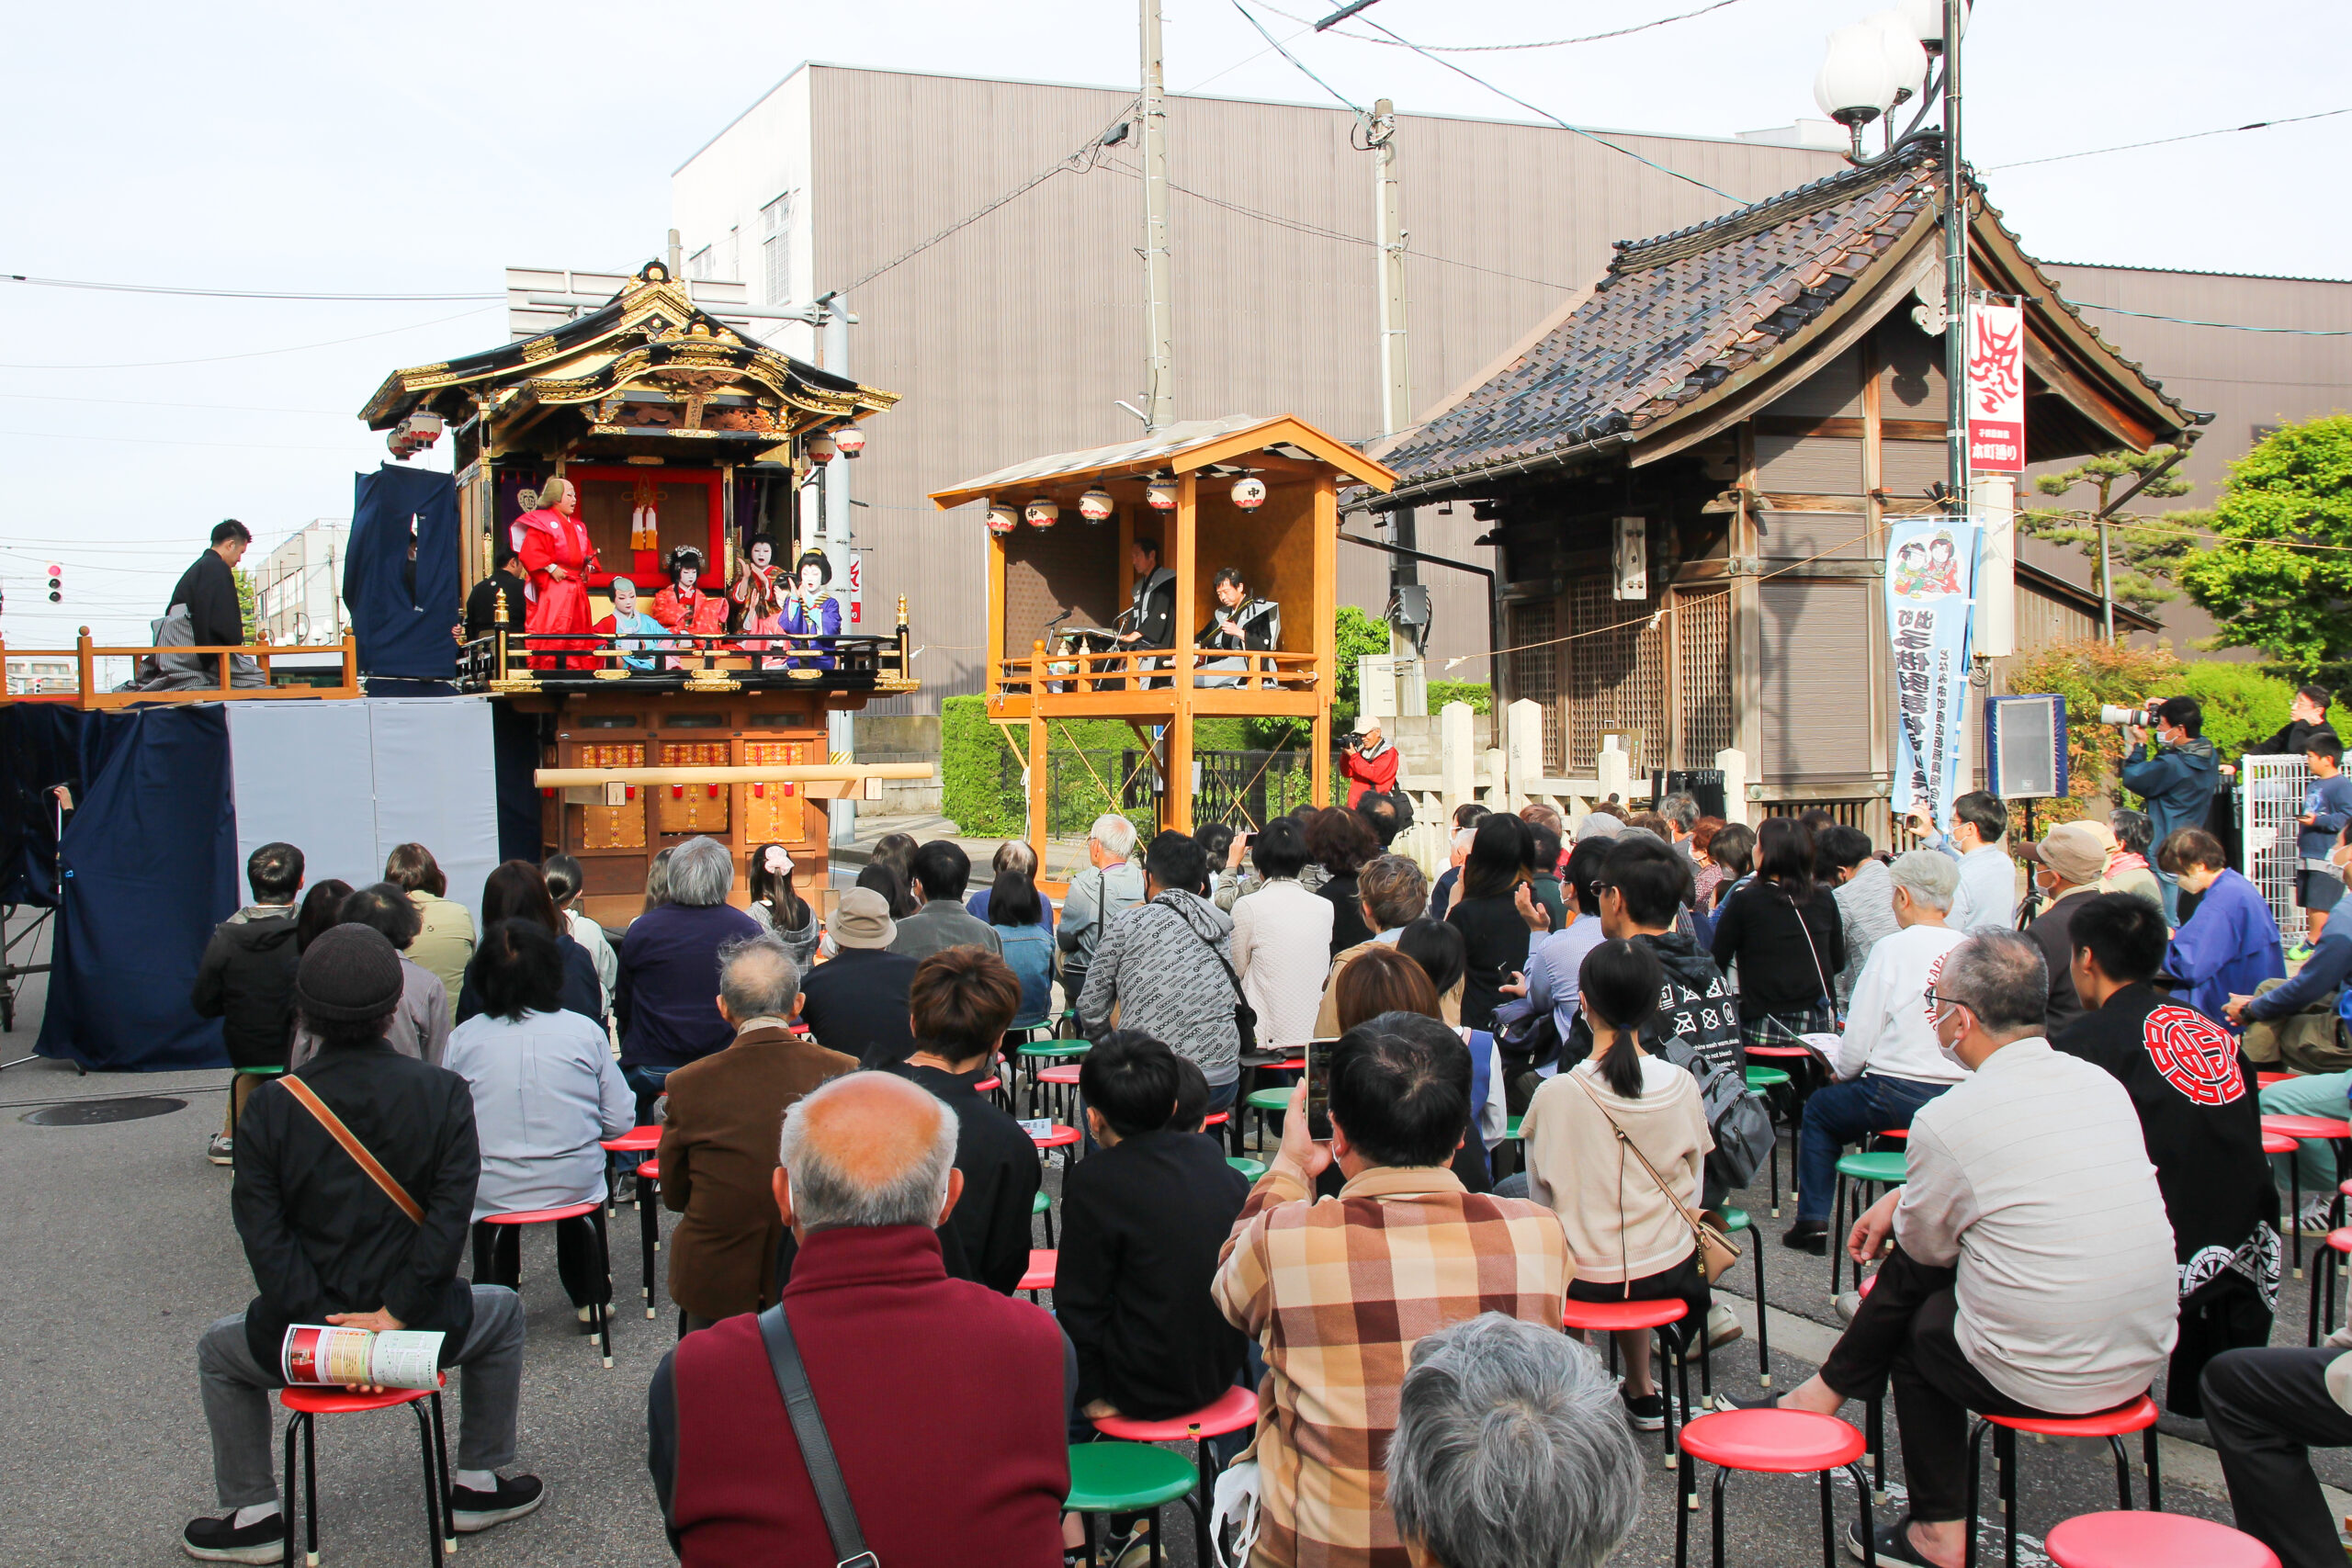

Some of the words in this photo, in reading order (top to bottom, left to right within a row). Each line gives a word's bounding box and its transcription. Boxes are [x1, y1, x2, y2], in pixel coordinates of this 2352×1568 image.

[1972, 442, 2017, 461] 本町通り
[1248, 487, 1260, 499] 中
[1027, 508, 1037, 518] 中
[1928, 952, 1950, 987] CAPT
[1719, 1049, 1733, 1057] bleach
